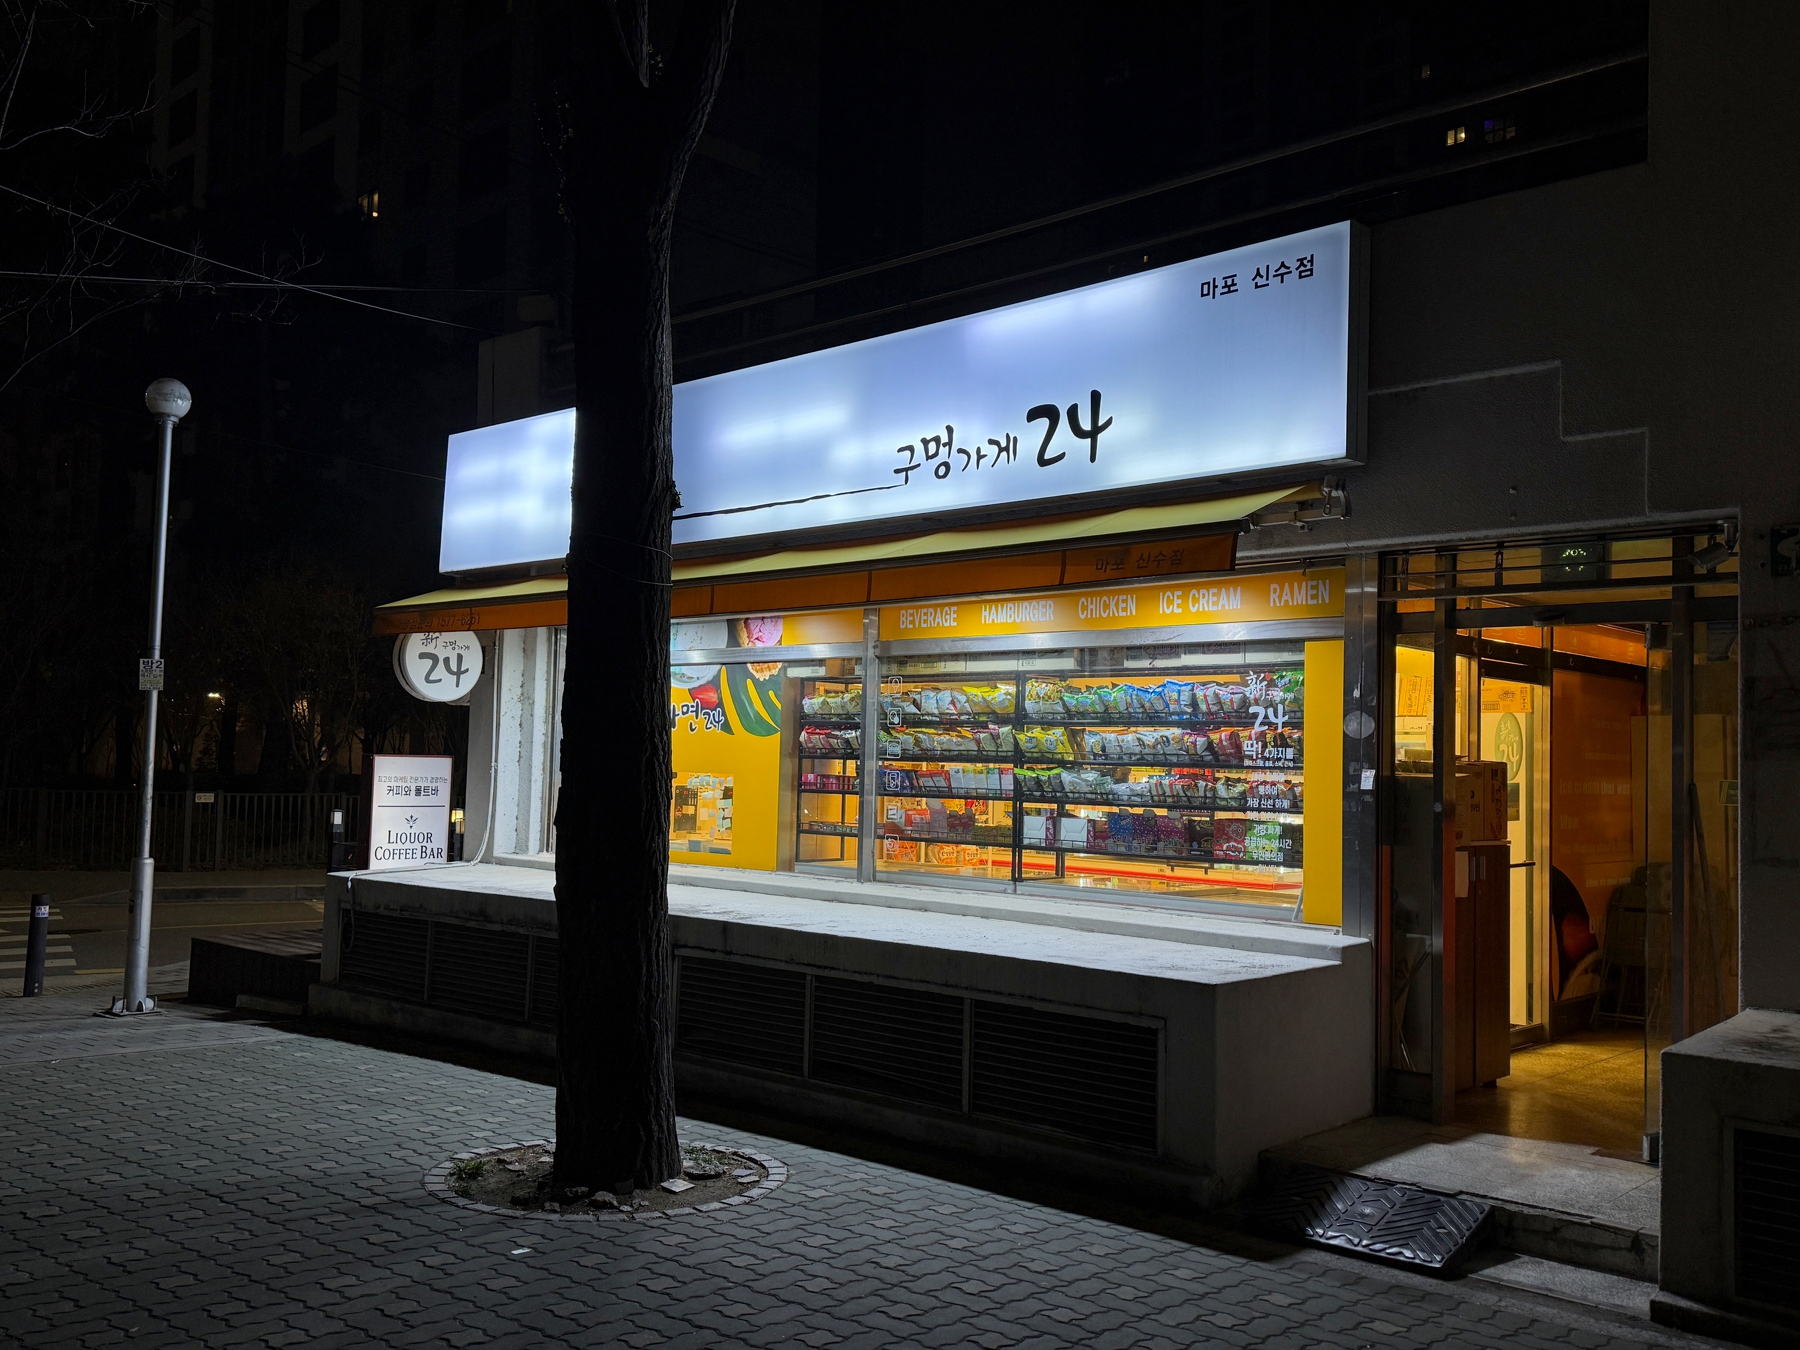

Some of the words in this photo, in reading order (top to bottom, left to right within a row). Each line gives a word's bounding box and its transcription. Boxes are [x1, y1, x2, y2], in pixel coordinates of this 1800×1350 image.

[1199, 275, 1240, 301] 마포
[1250, 254, 1316, 290] 신수점
[893, 424, 1019, 487] 구멍가게
[1026, 389, 1113, 467] 24
[1095, 557, 1126, 573] 마포
[1136, 548, 1186, 570] 신수점
[899, 605, 958, 631] BEVERAGE
[981, 598, 1054, 625] HAMBURGER
[1078, 593, 1137, 619] CHICKEN
[1158, 591, 1183, 615] ICE
[1188, 585, 1242, 612] CREAM
[1269, 579, 1331, 607] RAMEN
[442, 639, 470, 651] 구멍가게
[418, 652, 470, 688] 24
[1248, 703, 1289, 732] 24
[1243, 740, 1262, 759] 딱!
[1264, 747, 1294, 760] 4가지를
[386, 785, 412, 797] 커피와
[414, 785, 439, 797] 몰트바
[1600, 780, 1614, 795] that
[1617, 783, 1631, 795] was
[1246, 797, 1259, 808] 가장
[1260, 798, 1274, 808] 신선
[1275, 798, 1290, 809] 하게!
[387, 829, 433, 845] LIQUOR
[1270, 838, 1293, 849] 24시간
[374, 846, 418, 861] COFFEE
[420, 845, 443, 860] BAR
[1251, 850, 1284, 862] 무인편의점
